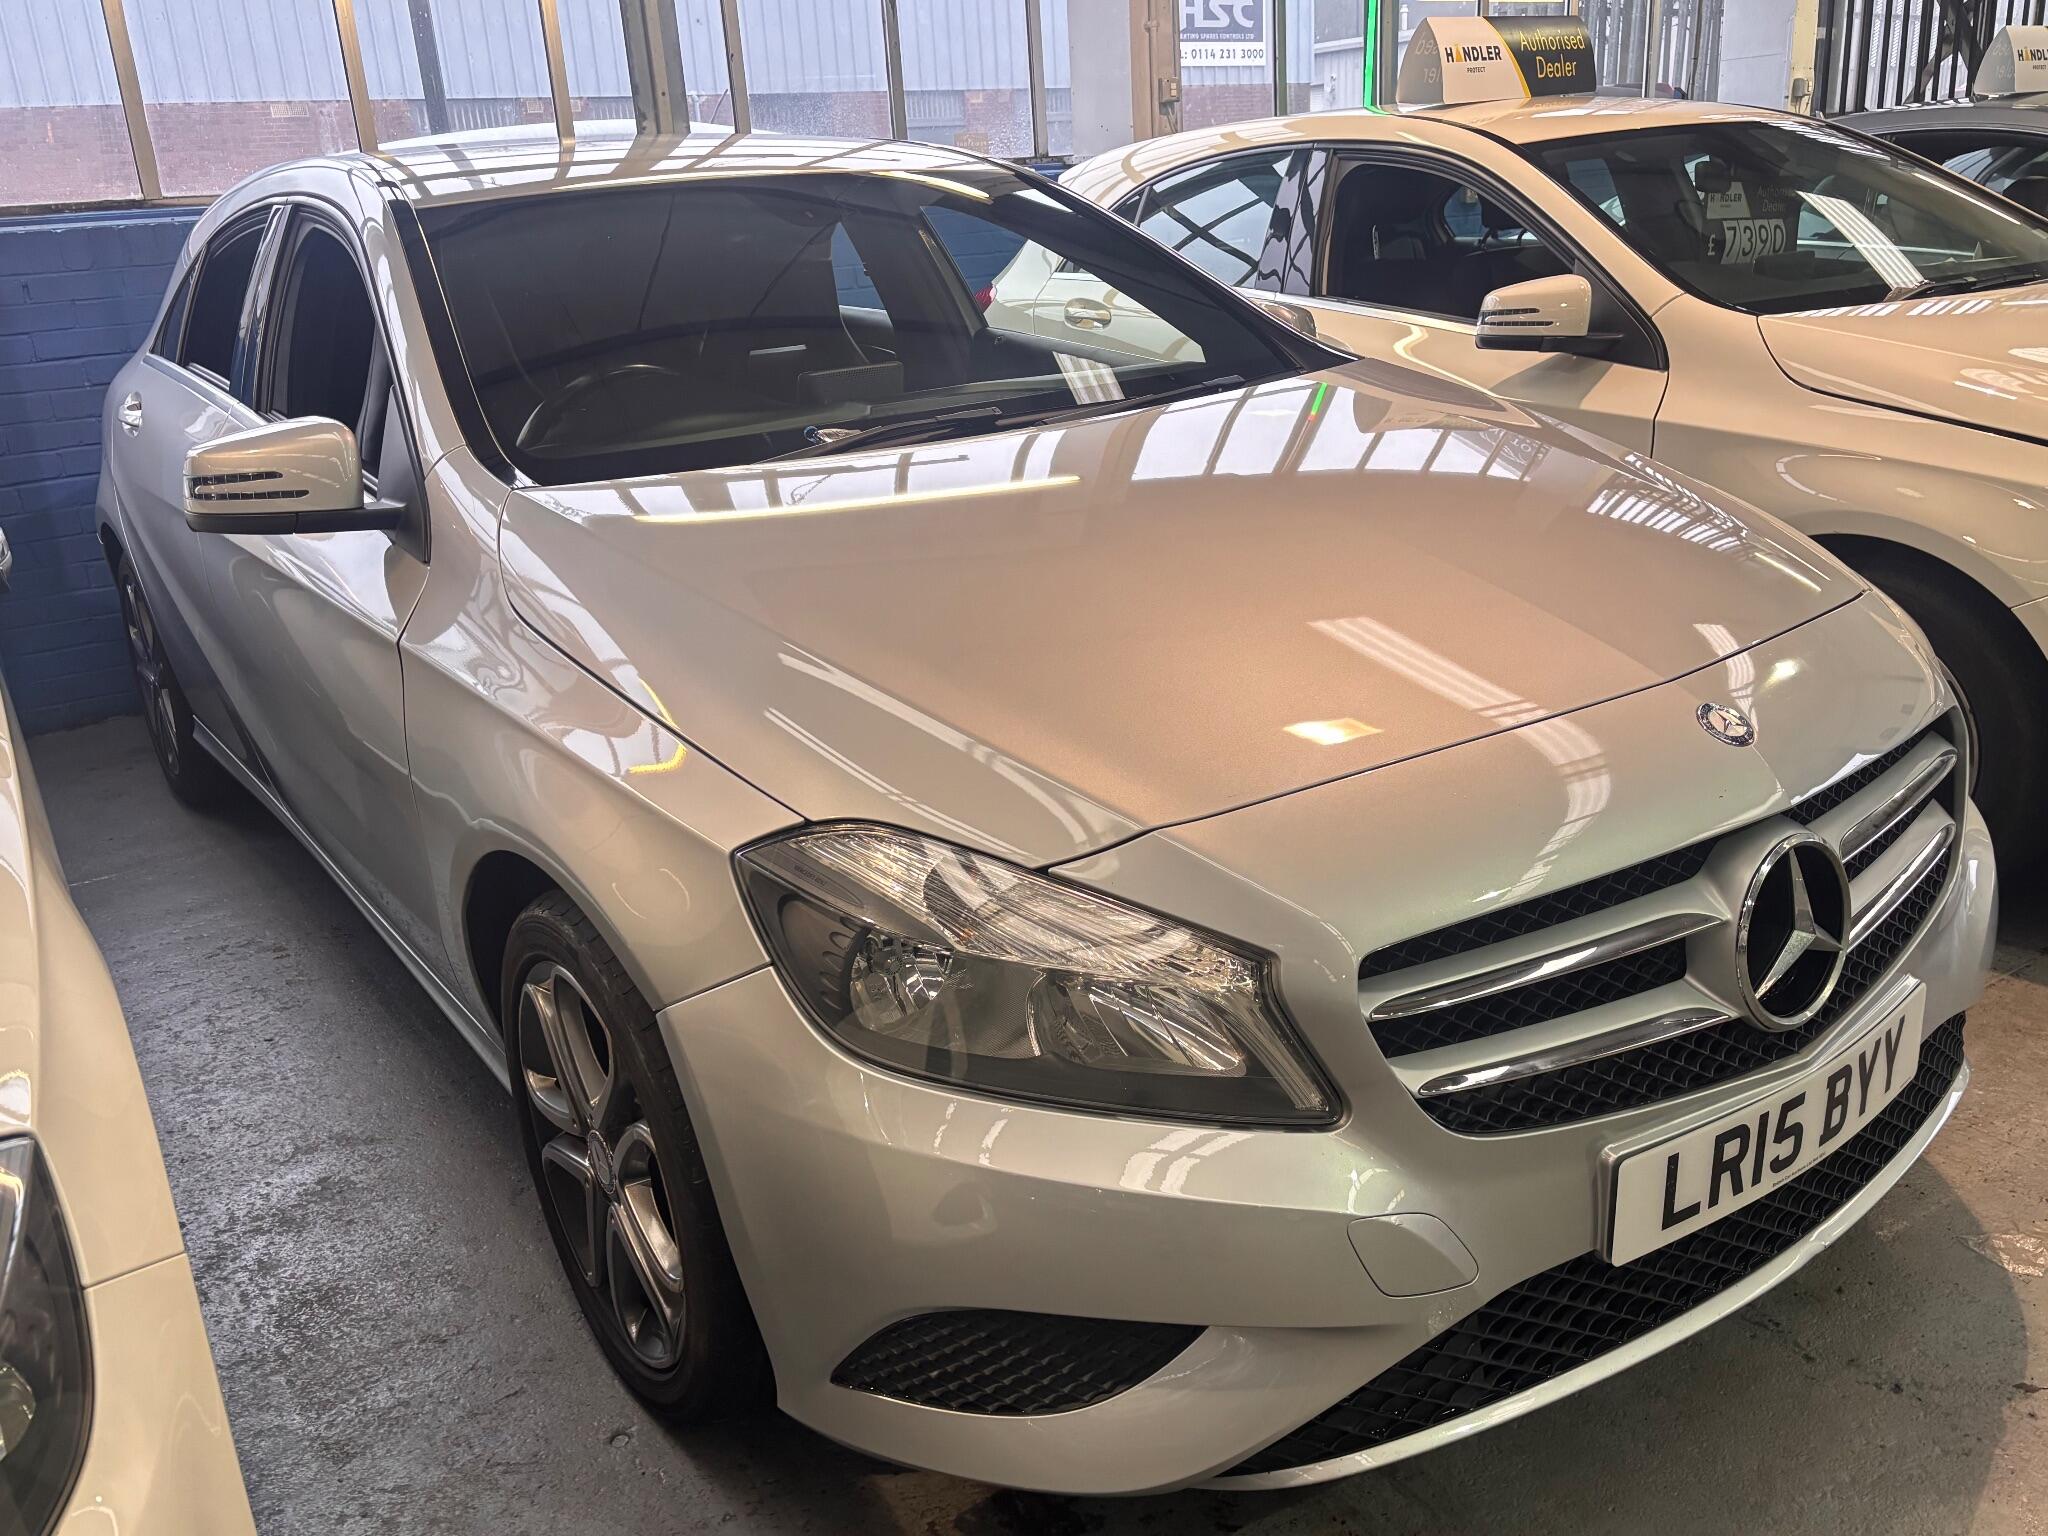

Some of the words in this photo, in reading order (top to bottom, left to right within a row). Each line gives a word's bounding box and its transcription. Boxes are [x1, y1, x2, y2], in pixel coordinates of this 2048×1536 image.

[1519, 27, 1586, 52] Authorised
[1191, 48, 1216, 60] 0114
[1219, 48, 1236, 60] 231
[1240, 48, 1264, 60] 3000
[1535, 53, 1577, 79] Dealer
[1466, 66, 1486, 74] PROTECT
[1661, 1090, 1807, 1231] LR15
[1818, 1014, 1906, 1148] BYY
